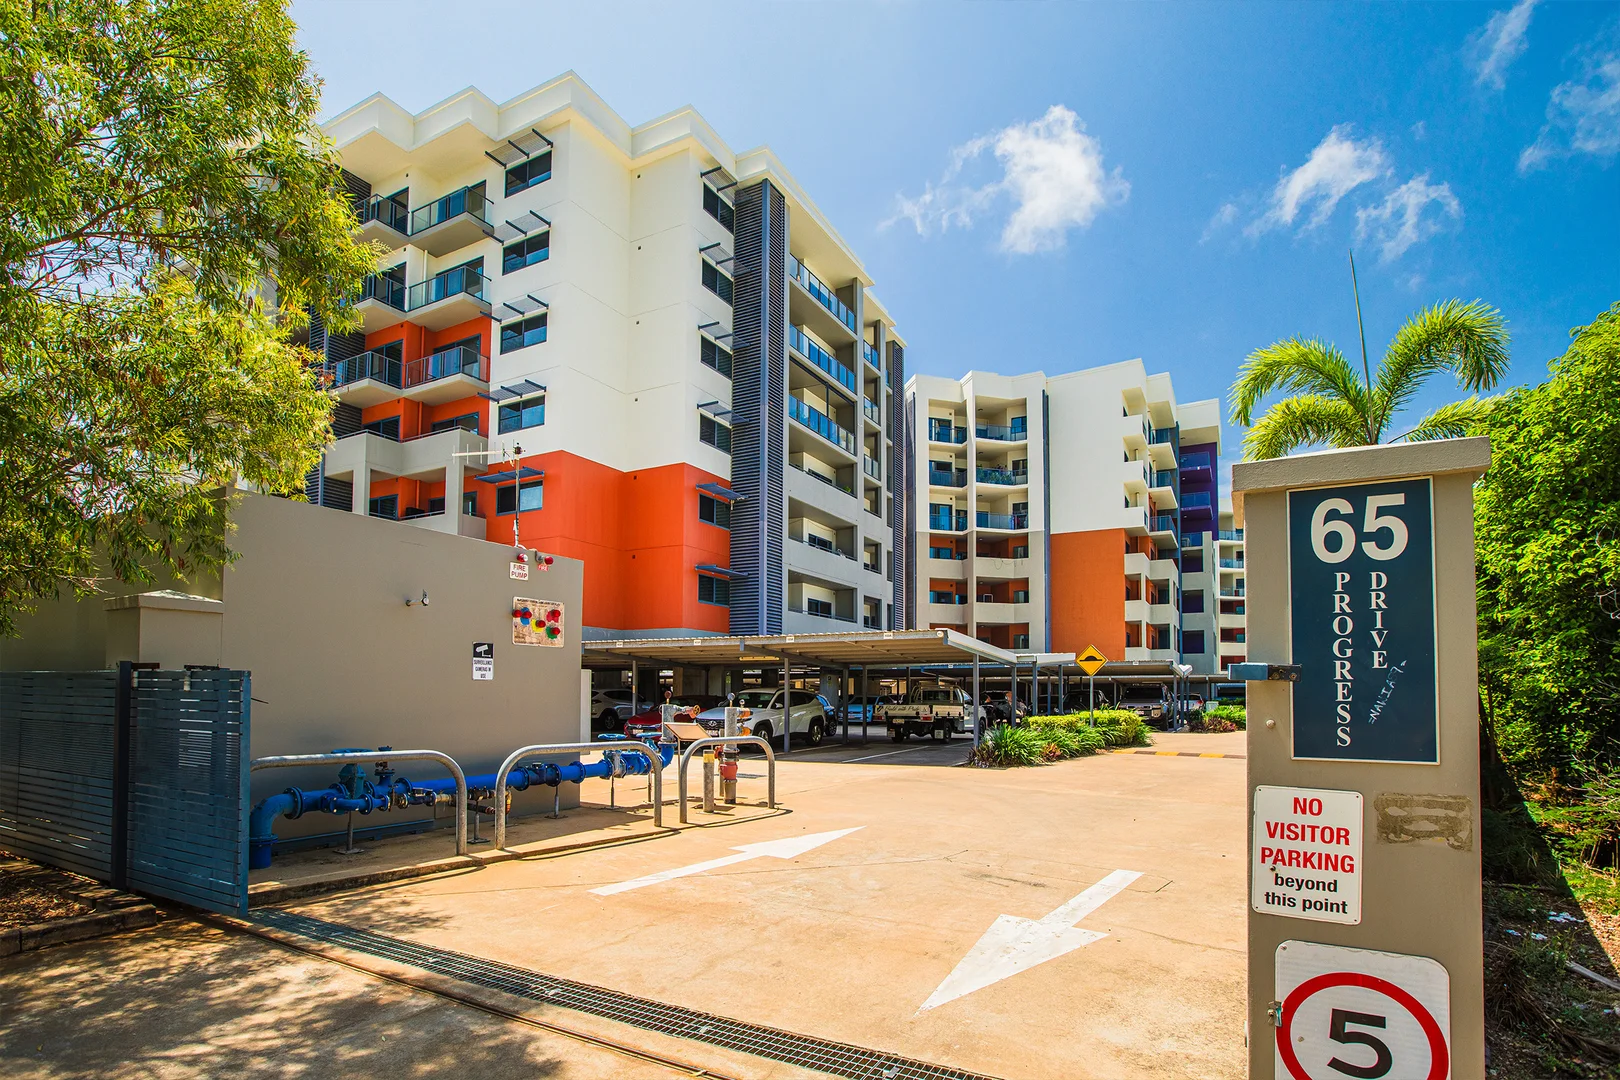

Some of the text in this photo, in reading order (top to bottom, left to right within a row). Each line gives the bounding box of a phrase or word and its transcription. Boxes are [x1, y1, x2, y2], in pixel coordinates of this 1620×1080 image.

[1310, 493, 1409, 564] 65
[511, 571, 528, 579] PUMP
[513, 564, 526, 572] FIRE
[1369, 571, 1388, 669] DRIVE
[1332, 572, 1354, 747] PROGRESS
[1293, 797, 1323, 816] NO
[1265, 821, 1350, 846] VISITOR
[1260, 846, 1355, 874] PARKING
[1274, 873, 1338, 893] beyond
[1264, 891, 1348, 915] this point
[1327, 1008, 1393, 1080] 5
